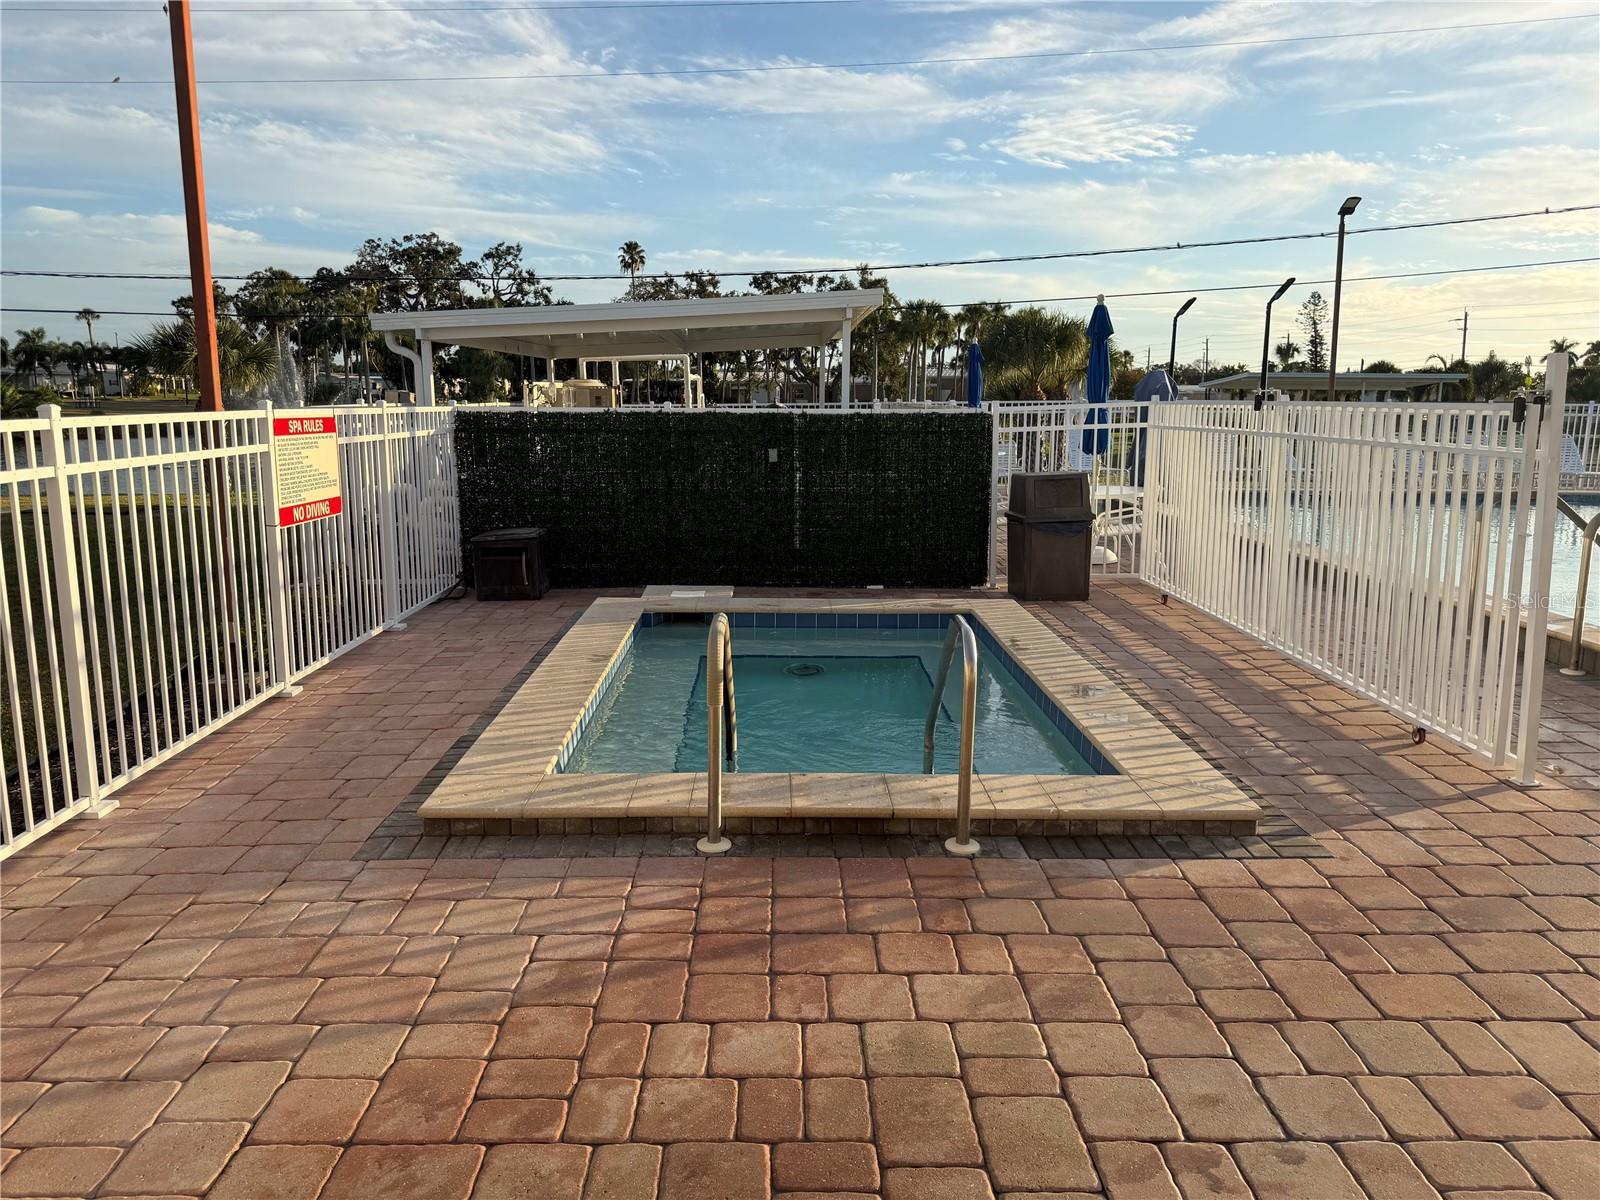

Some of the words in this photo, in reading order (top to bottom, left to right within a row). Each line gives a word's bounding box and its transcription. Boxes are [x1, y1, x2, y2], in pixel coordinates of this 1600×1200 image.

[288, 419, 302, 433] SPA
[303, 418, 324, 433] RULES
[293, 506, 304, 522] NO
[306, 500, 331, 519] DIVING
